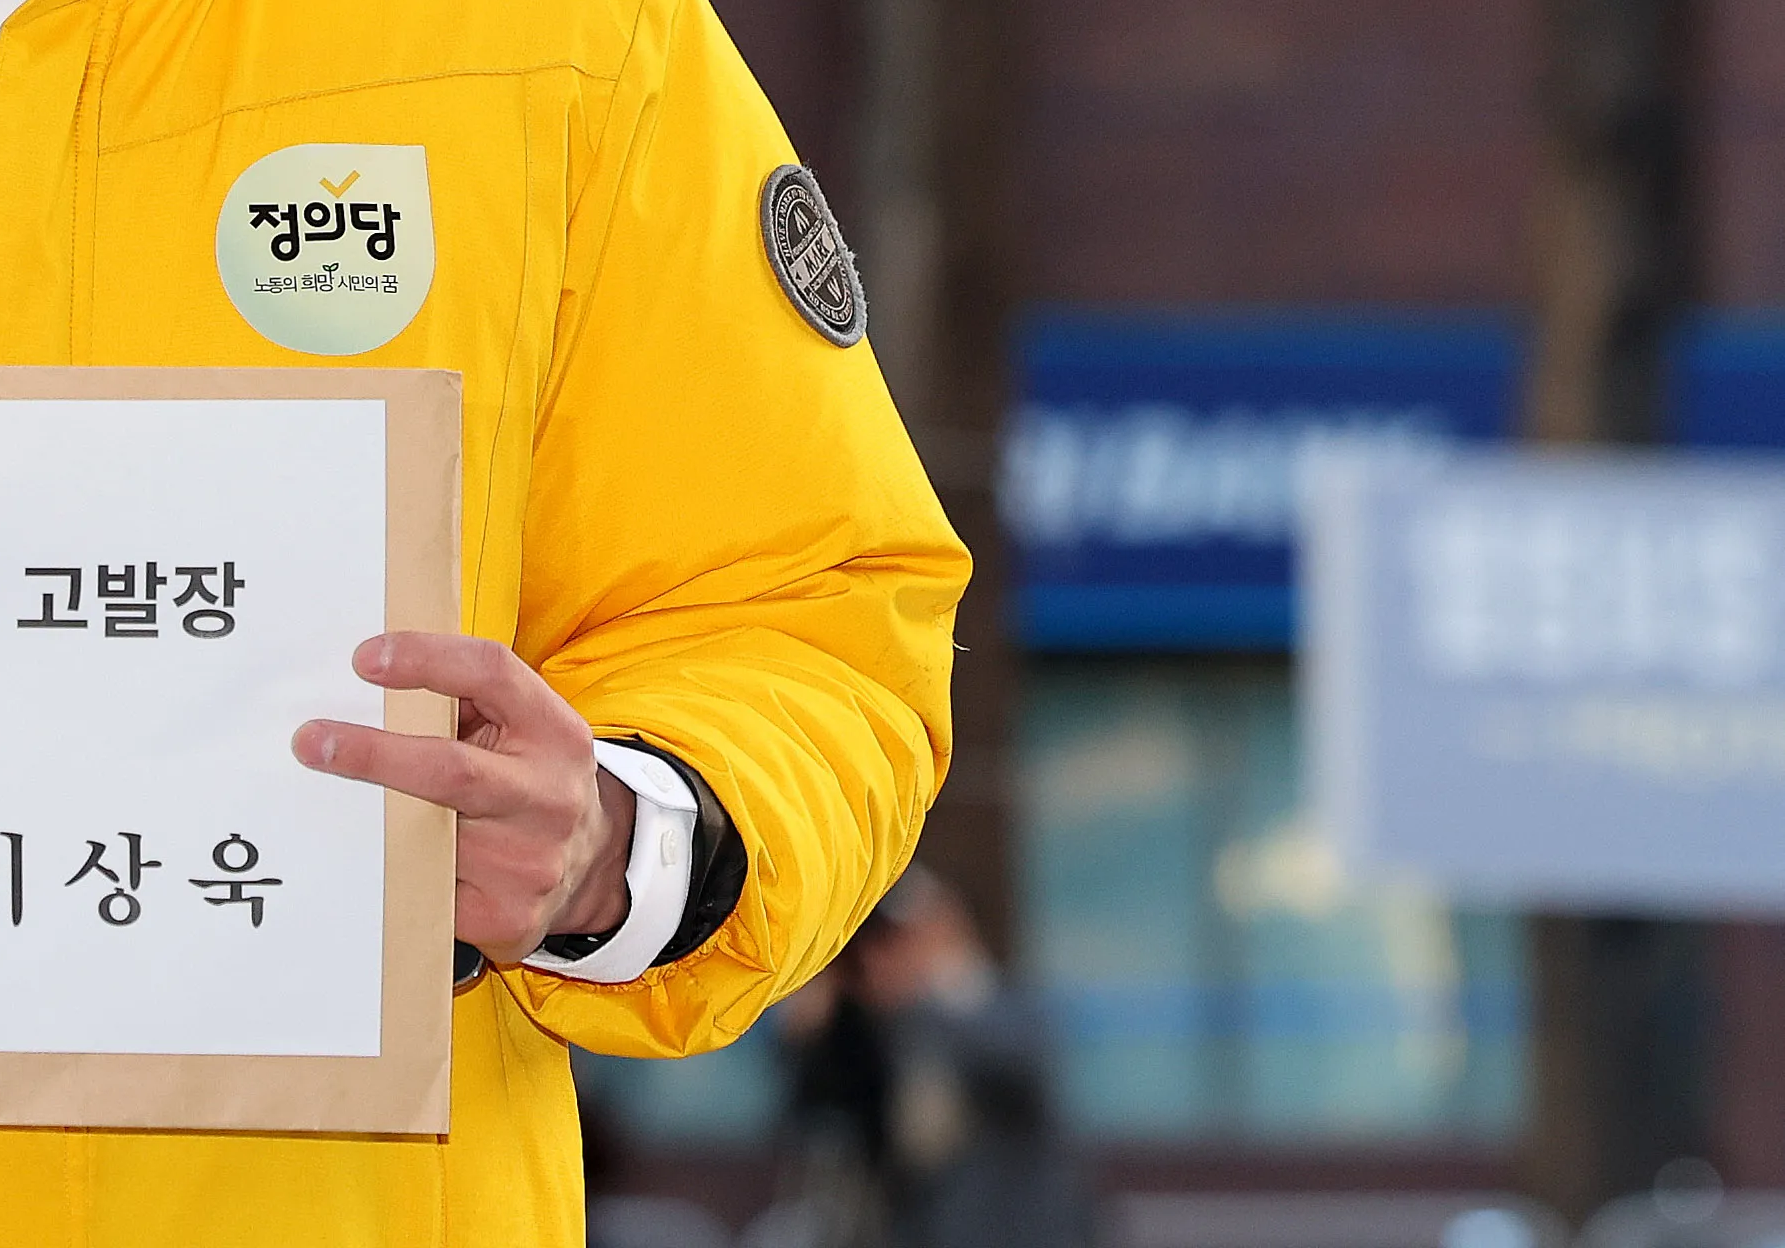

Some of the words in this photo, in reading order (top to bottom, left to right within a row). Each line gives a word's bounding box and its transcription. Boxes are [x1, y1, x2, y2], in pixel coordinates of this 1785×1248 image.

[248, 201, 401, 262] 정의당
[254, 276, 298, 294] 노동의
[301, 272, 335, 293] 희망
[338, 274, 379, 292] 시민의
[381, 274, 399, 294] 꿈
[17, 560, 246, 640] 고발장
